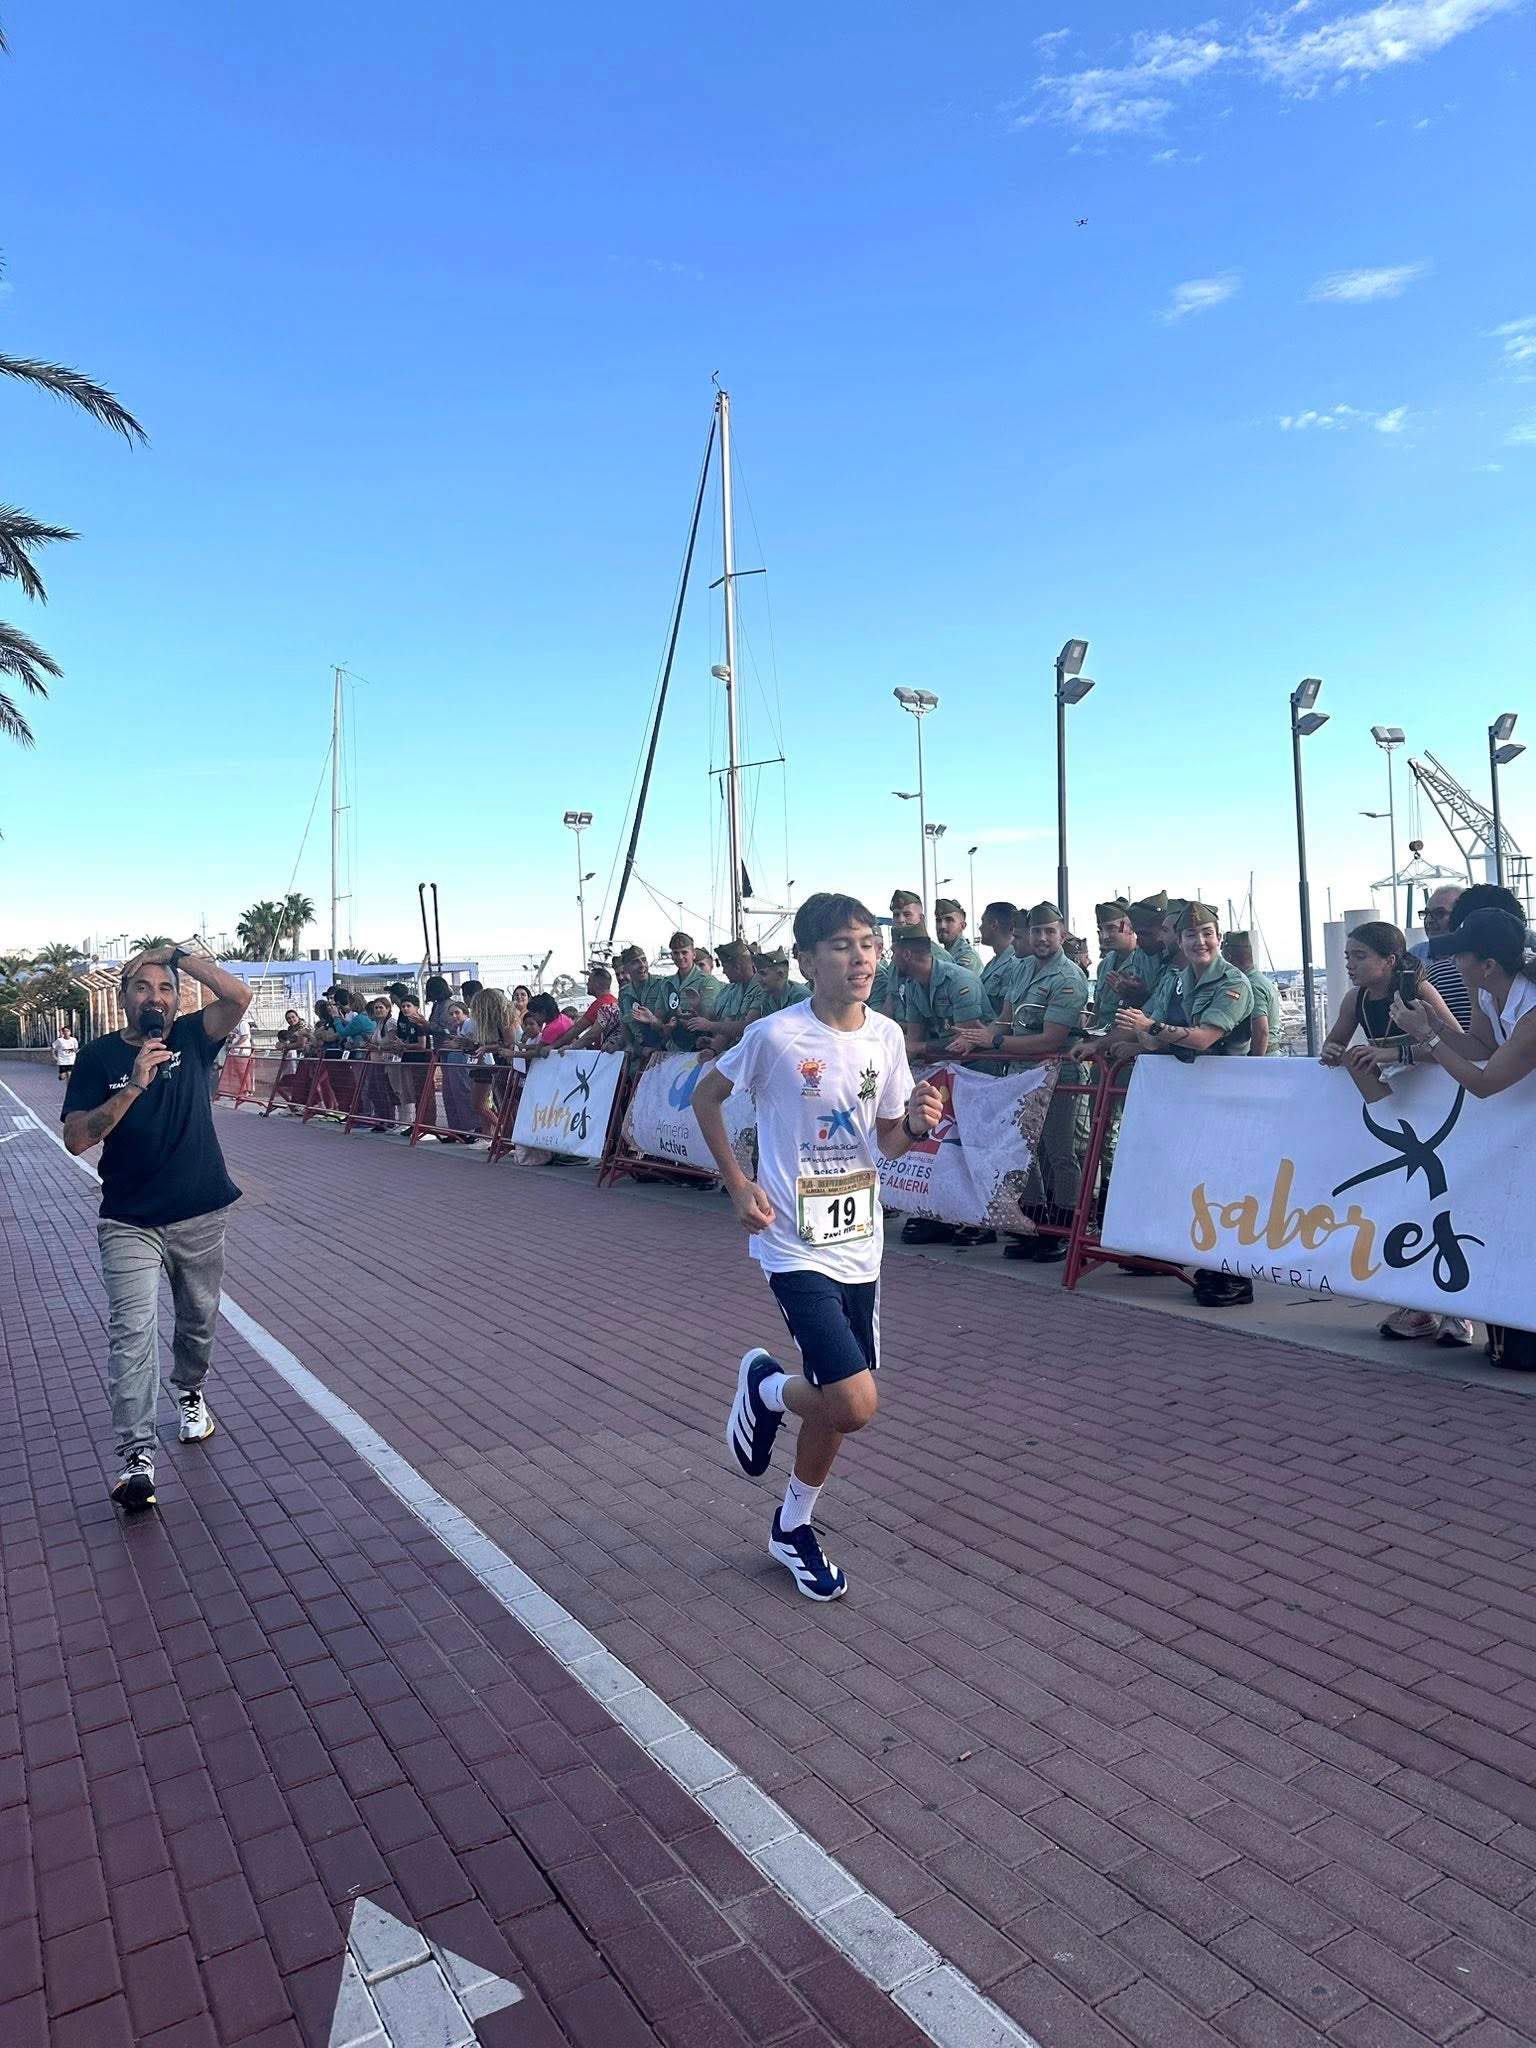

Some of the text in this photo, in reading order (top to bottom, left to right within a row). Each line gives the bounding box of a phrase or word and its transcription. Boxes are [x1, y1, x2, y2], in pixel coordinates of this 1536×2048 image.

[532, 1088, 591, 1140] sabores
[656, 1119, 689, 1139] Almería
[660, 1137, 688, 1156] Activa
[876, 1157, 932, 1179] DEPORTES
[880, 1172, 887, 1184] E
[827, 1196, 856, 1228] 19
[1191, 1158, 1486, 1293] sabores
[1221, 1257, 1335, 1295] ALMERÍA
